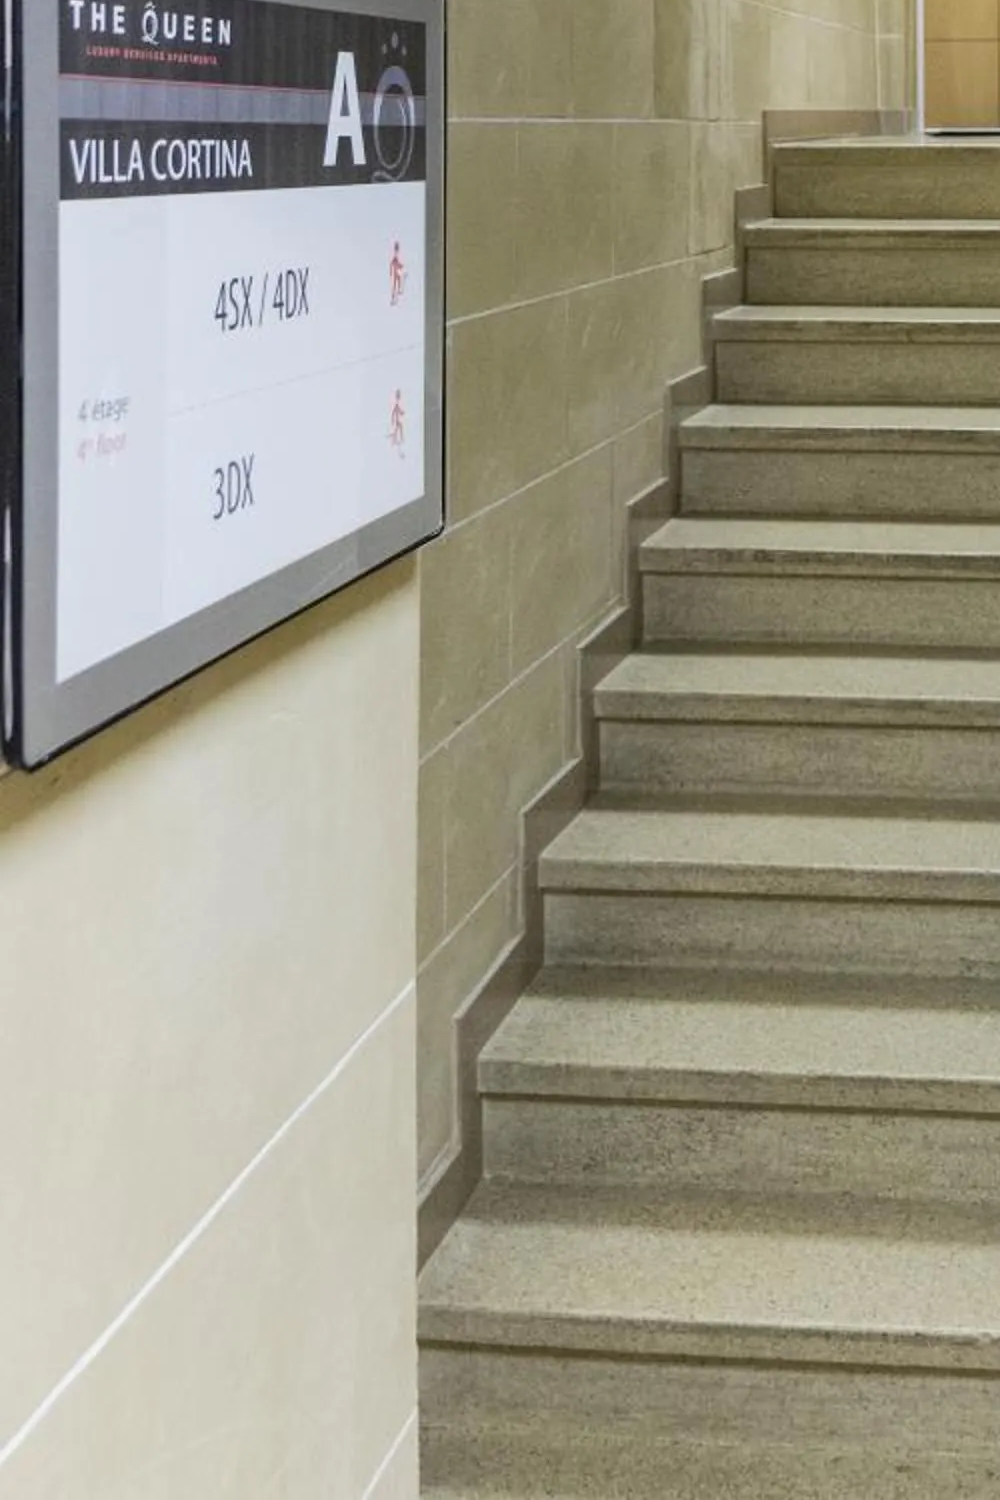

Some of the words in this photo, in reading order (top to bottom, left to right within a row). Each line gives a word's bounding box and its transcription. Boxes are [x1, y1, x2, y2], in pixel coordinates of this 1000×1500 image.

[69, 0, 126, 34] THE
[142, 2, 231, 45] QUEEN
[323, 51, 367, 167] A
[69, 138, 145, 184] VILLA
[151, 138, 253, 181] CORTINA
[214, 275, 253, 332] 4SX
[259, 272, 269, 327] /
[272, 267, 310, 321] 4DX
[213, 454, 254, 520] 3DX
